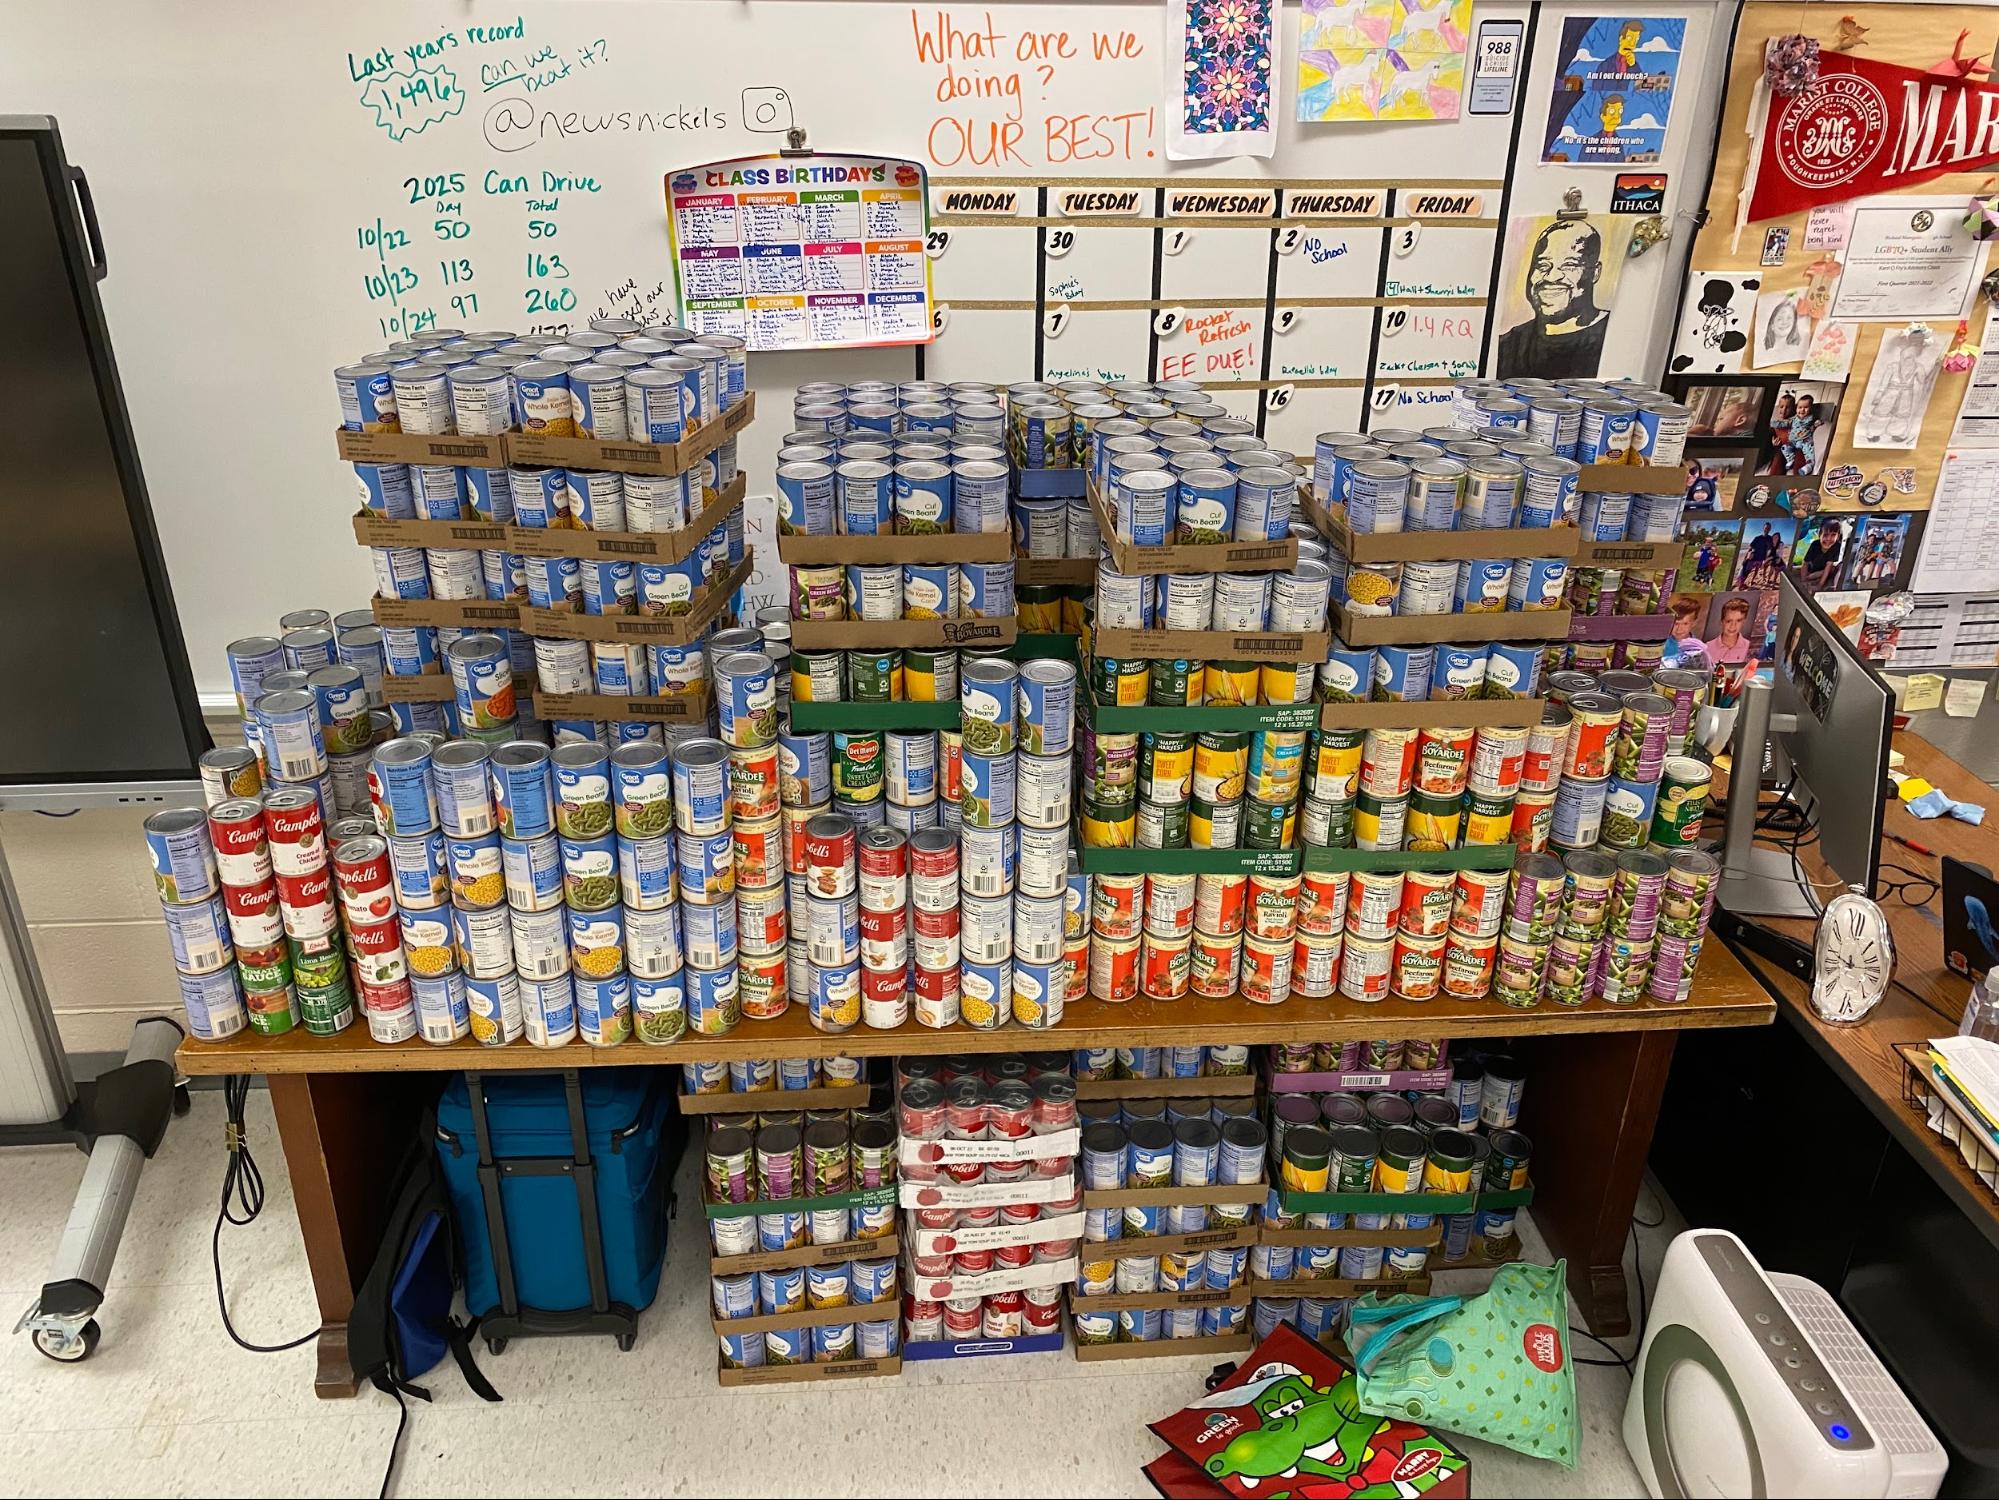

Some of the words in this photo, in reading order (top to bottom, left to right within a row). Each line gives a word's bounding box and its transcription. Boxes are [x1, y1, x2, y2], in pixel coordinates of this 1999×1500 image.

[912, 9, 1007, 67] What
[1016, 35, 1077, 61] are
[1092, 28, 1144, 62] we
[348, 48, 394, 81] Last
[467, 16, 524, 44] record
[525, 45, 558, 68] we
[1488, 42, 1512, 54] 988
[521, 57, 572, 93] beat
[578, 39, 609, 67] it?
[1623, 72, 1648, 80] touch?
[382, 76, 451, 119] 1,496
[1784, 81, 1830, 133] MARIST
[1834, 80, 1881, 131] COLLEGE
[483, 97, 727, 152] @newsnickels
[927, 116, 1034, 168] OUR
[1045, 110, 1159, 161] BEST!
[1600, 136, 1629, 145] children
[1631, 137, 1644, 145] who
[705, 168, 770, 188] CLASS
[775, 163, 886, 185] BIRTHDAYS
[403, 174, 466, 204] 2025
[484, 170, 529, 194] Can
[542, 171, 602, 193] Drive
[436, 202, 462, 216] Day
[525, 198, 559, 212] Total
[685, 197, 723, 207] JANUARY
[746, 195, 787, 205] FEBRUARY
[814, 193, 845, 202] MARCH
[879, 192, 903, 200] APRIL
[946, 193, 1016, 211] MONDAY
[1065, 192, 1138, 212] TUESDAY
[1172, 196, 1271, 213] WEDNESDAY
[1291, 196, 1375, 213] THURSDAY
[1416, 196, 1474, 213] FRIDAY
[1613, 201, 1660, 211] ITHACA
[358, 218, 411, 262] 10/22
[434, 220, 471, 240] 50
[528, 220, 557, 239] 50
[927, 232, 948, 250] 29
[1050, 231, 1074, 248] 30
[1174, 231, 1184, 249] 1
[1284, 230, 1298, 247] 2
[1402, 231, 1413, 249] 3
[1827, 235, 1842, 243] kind
[700, 250, 719, 258] MAY
[761, 247, 783, 255] JUNE
[822, 245, 843, 254] JULY
[878, 244, 909, 252] AUGUST
[1312, 243, 1348, 264] School
[1875, 246, 1907, 254] LGBTQ+
[1939, 245, 1953, 254] Ally
[364, 264, 419, 307] 10/23
[441, 259, 473, 286] 113
[528, 253, 570, 279] 163
[692, 300, 738, 309] SEPTEMBER
[757, 298, 794, 307] OCTOBER
[815, 297, 858, 305] NOVEMBER
[875, 294, 918, 304] DECEMBER
[379, 307, 437, 339] 10/24
[450, 294, 479, 318] 97
[525, 288, 578, 314] 260
[934, 311, 942, 328] 6
[1052, 313, 1062, 332] 7
[1162, 314, 1176, 330] 8
[1184, 310, 1234, 334] Rocket
[1281, 311, 1294, 327] 9
[1386, 310, 1406, 328] 10
[1199, 320, 1251, 345] Refresh
[1414, 315, 1434, 337] 1.4
[1162, 352, 1197, 381] EE
[1206, 343, 1254, 373] DUE!
[1271, 390, 1288, 405] 16
[1376, 389, 1395, 405] 17
[1398, 392, 1413, 405] No
[1417, 391, 1454, 403] School
[1422, 746, 1464, 760] BOYARDEE
[1424, 761, 1458, 771] Beefaroni
[339, 866, 377, 883] mpbell's
[1257, 896, 1296, 906] BOYARDEE
[1401, 956, 1440, 966] BOYARDEE
[243, 971, 281, 981] SAUCE
[1196, 1416, 1239, 1444] GREEN
[1397, 1451, 1429, 1476] HARRY
